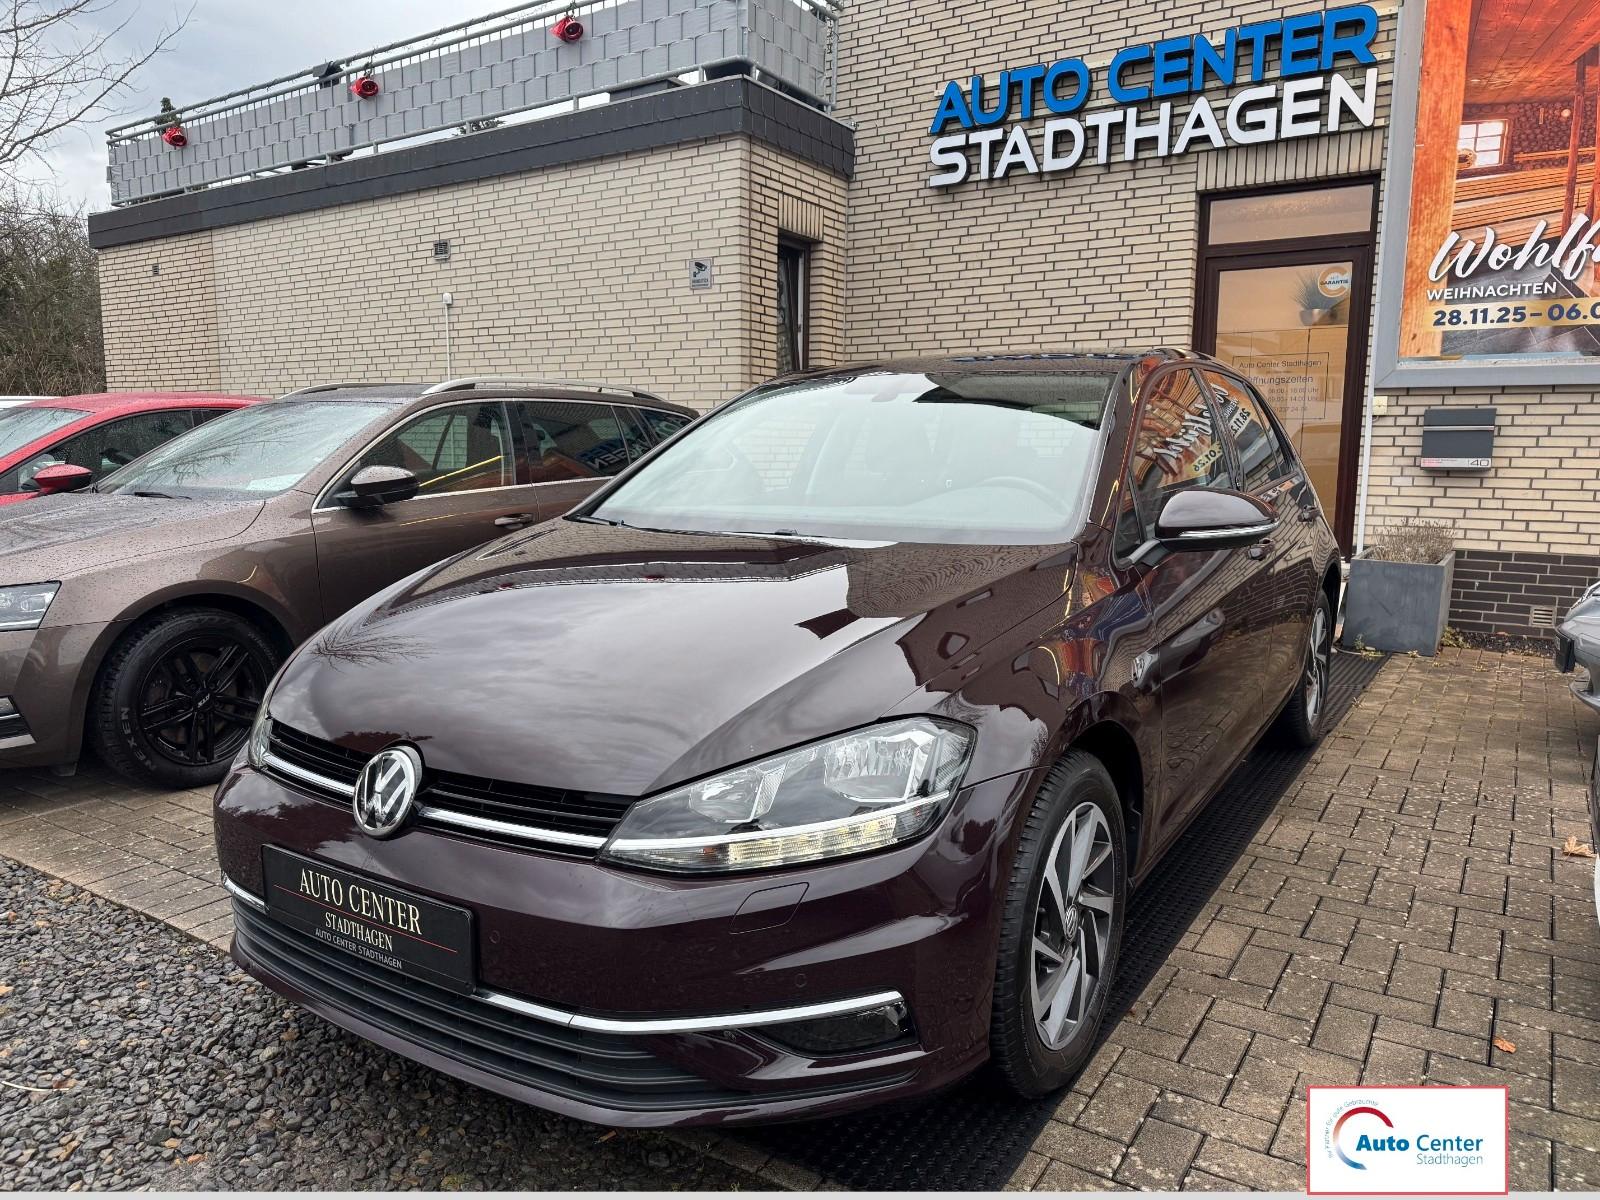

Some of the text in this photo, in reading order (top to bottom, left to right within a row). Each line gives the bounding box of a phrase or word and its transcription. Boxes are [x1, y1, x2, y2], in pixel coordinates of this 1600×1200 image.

[929, 4, 1379, 134] AUTO CENTER
[928, 68, 1379, 188] STADTHAGEN
[1426, 281, 1557, 301] WEIHNACHTEN
[1257, 360, 1280, 368] Center
[1282, 359, 1322, 368] Stadthagen
[120, 706, 157, 771] NEXEN
[299, 867, 422, 935] AUTO CENTER
[315, 927, 402, 969] AUTO CENTER STADTHAGEN
[325, 912, 393, 952] STADTHAGEN
